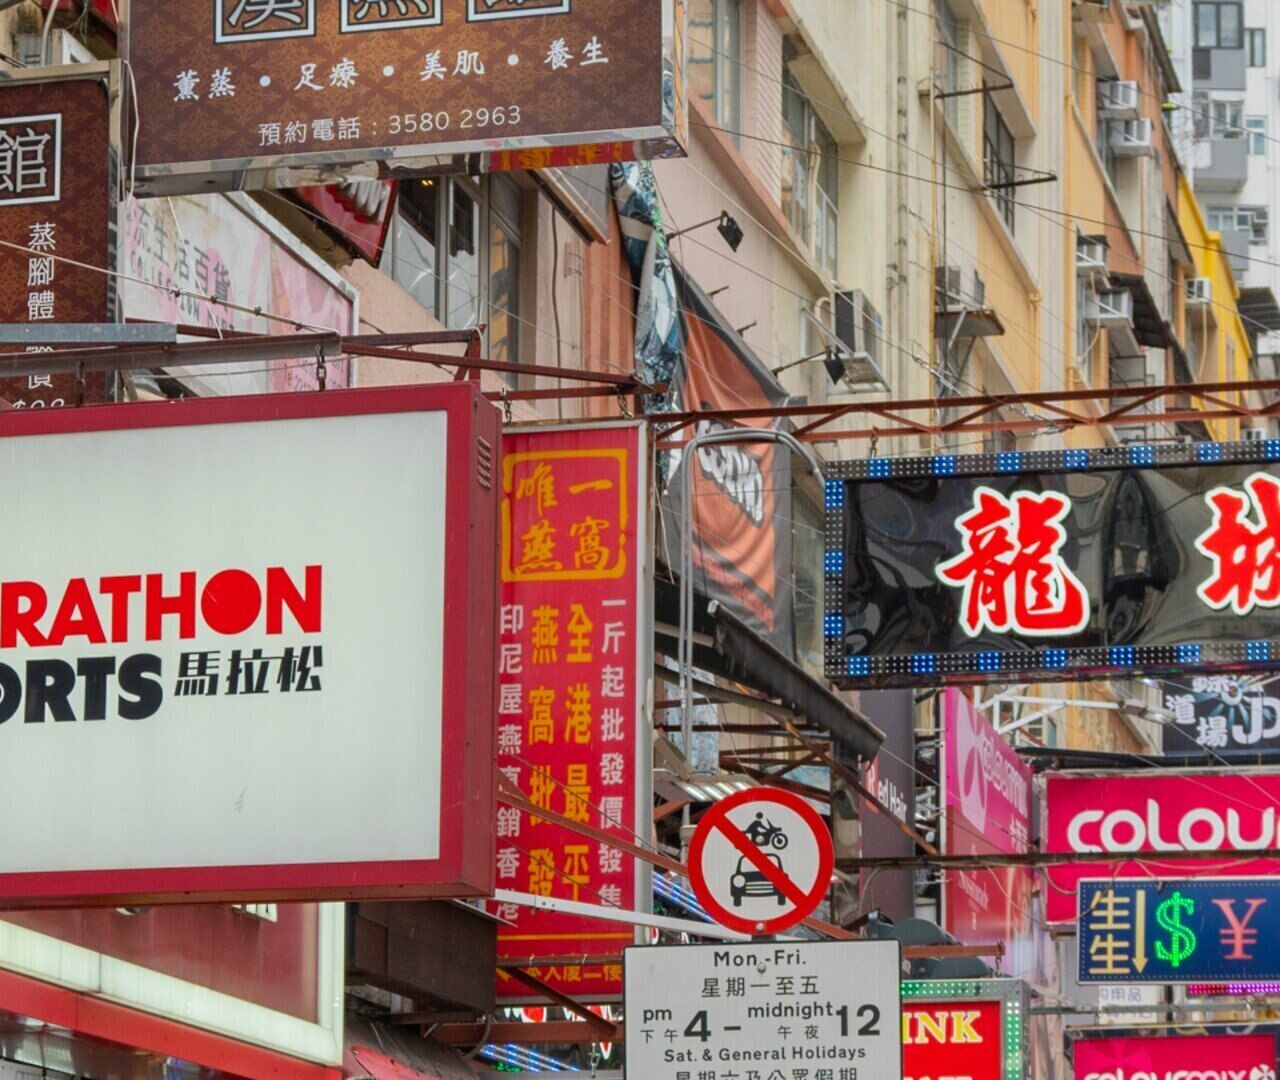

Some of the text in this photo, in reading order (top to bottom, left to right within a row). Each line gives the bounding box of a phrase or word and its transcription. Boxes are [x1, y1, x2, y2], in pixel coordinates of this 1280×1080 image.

[293, 57, 360, 92] 足療
[420, 47, 486, 83] 美肌
[543, 35, 611, 71] 養生
[388, 109, 451, 136] 3580
[460, 104, 522, 130] 2963
[174, 646, 322, 698] 馬拉松
[564, 603, 594, 902] 全港最平
[889, 781, 908, 824] Hair
[702, 975, 820, 998] 星期一至五
[641, 1024, 819, 1044] 下午 午夜
[643, 1000, 881, 1043] pm 4 midnight 12
[664, 1044, 866, 1062] Sat. & General Holidays
